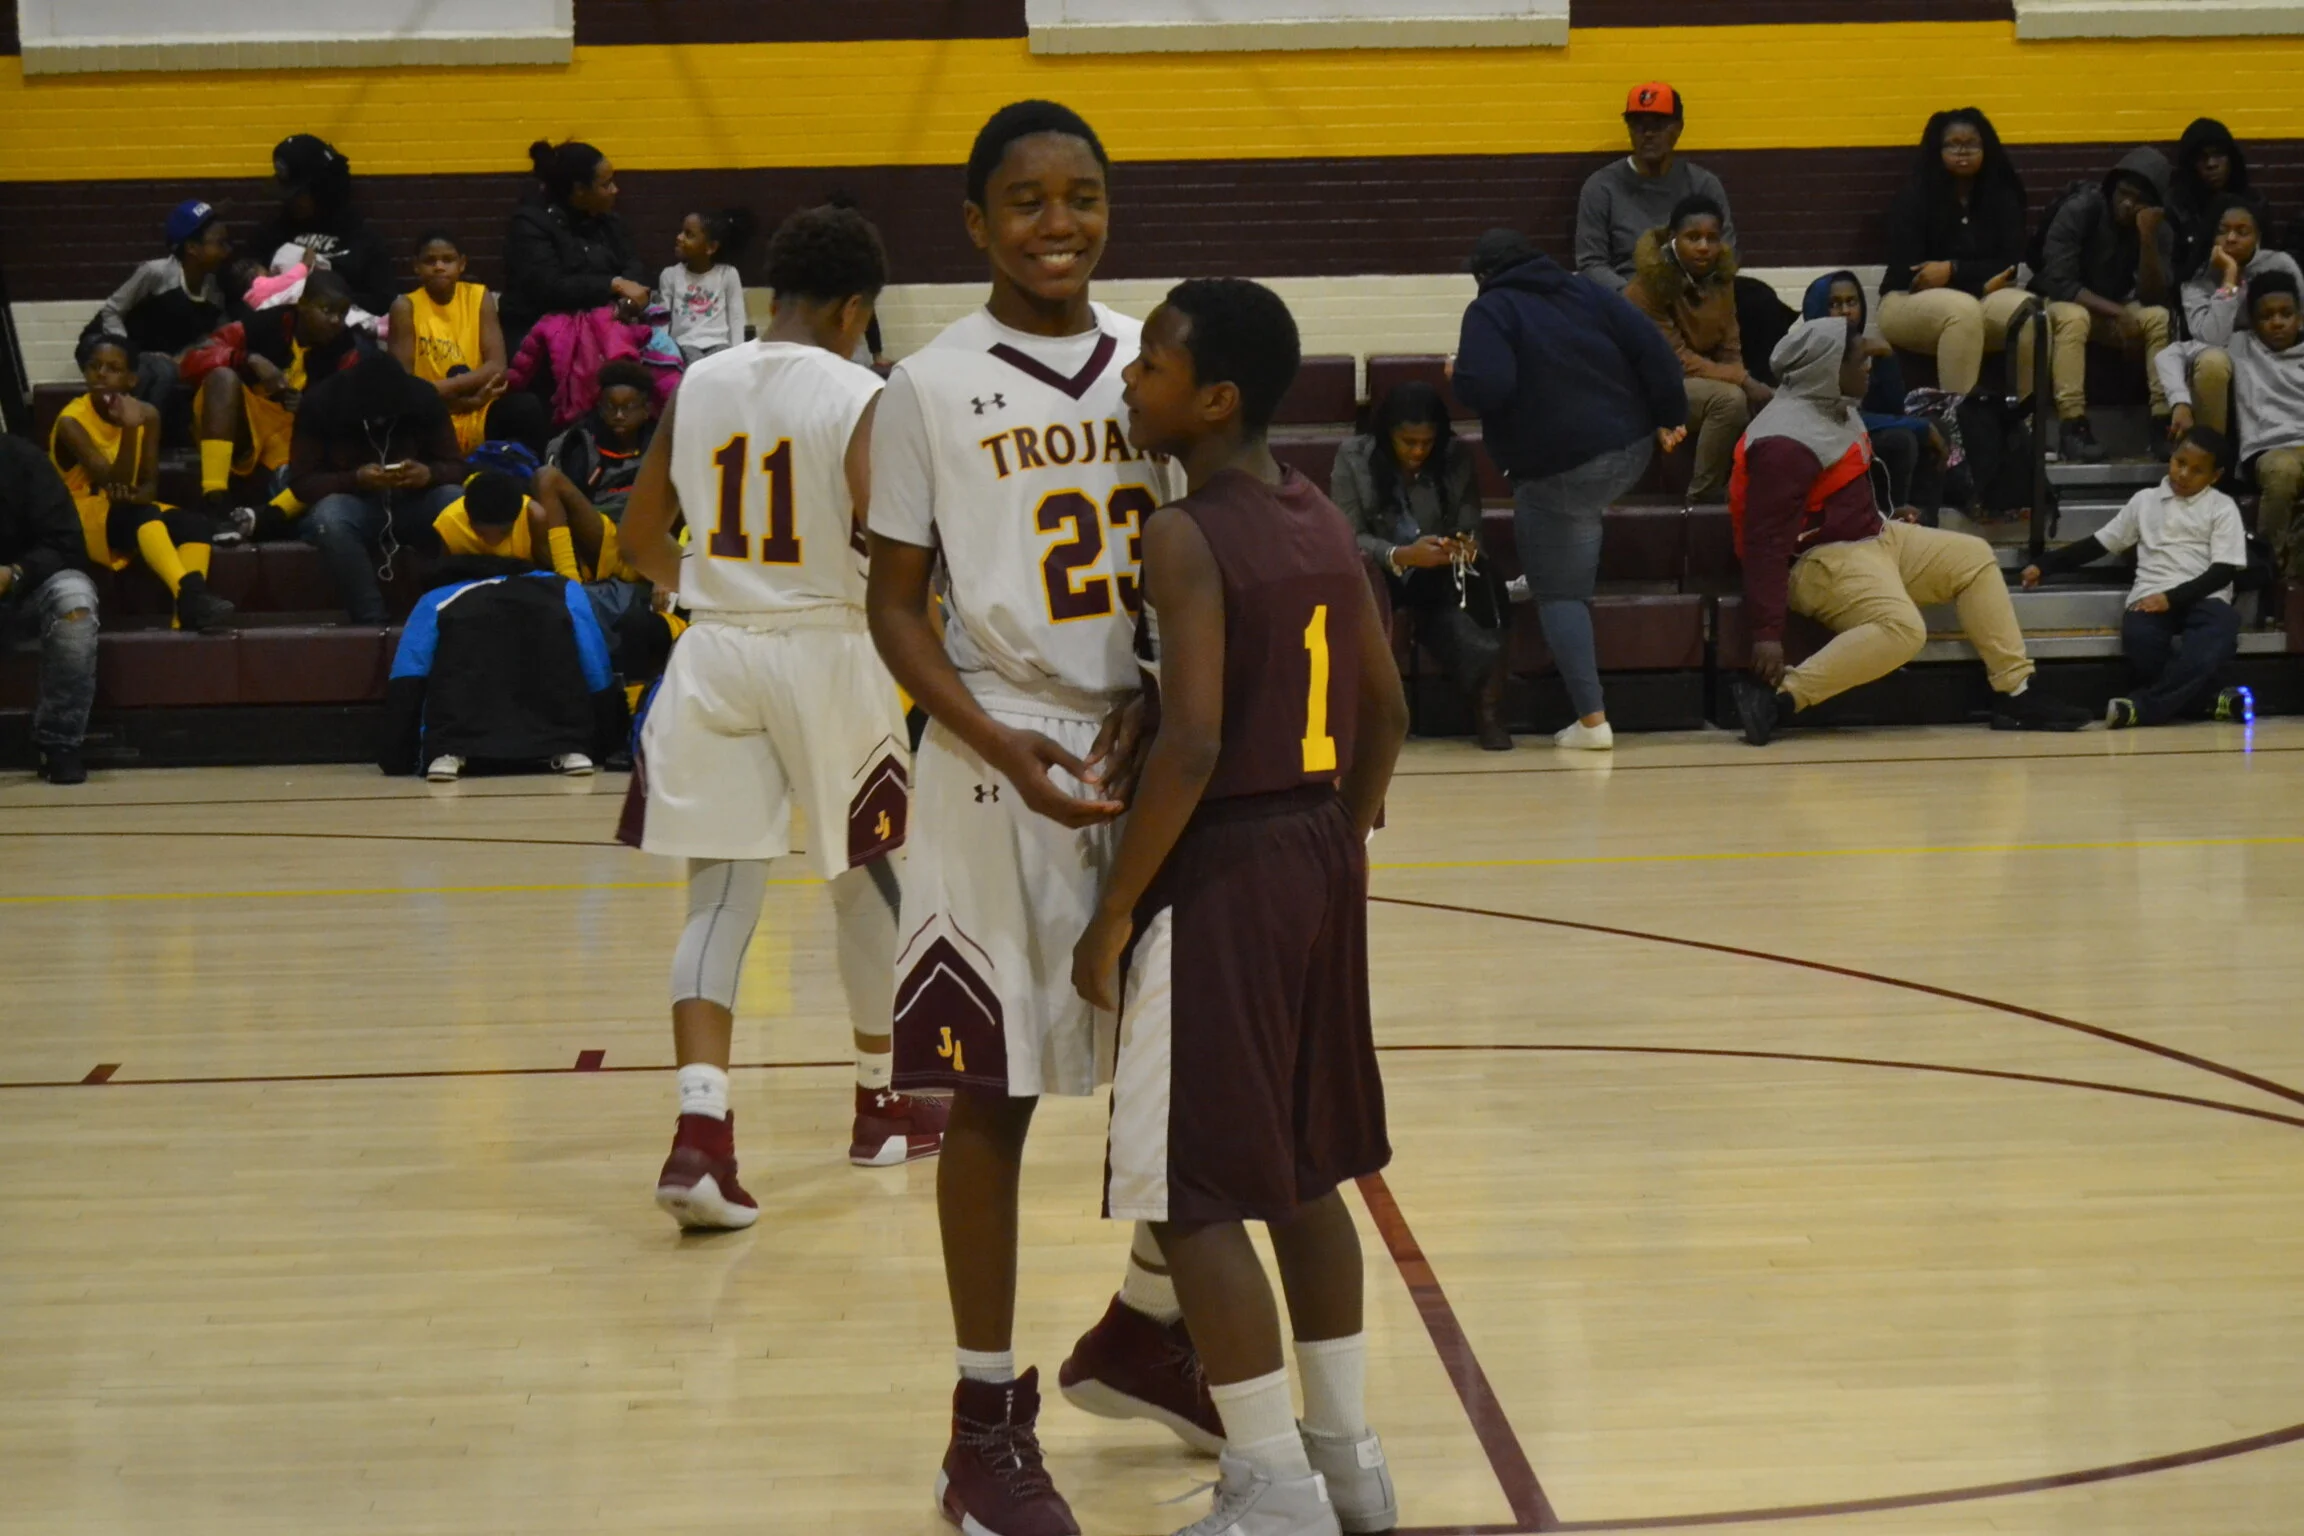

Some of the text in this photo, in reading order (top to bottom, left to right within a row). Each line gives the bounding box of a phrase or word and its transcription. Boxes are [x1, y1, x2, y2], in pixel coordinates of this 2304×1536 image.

[707, 432, 802, 566] 11
[980, 418, 1171, 480] TROJA
[1034, 483, 1158, 625] 23
[1301, 605, 1337, 772] 1
